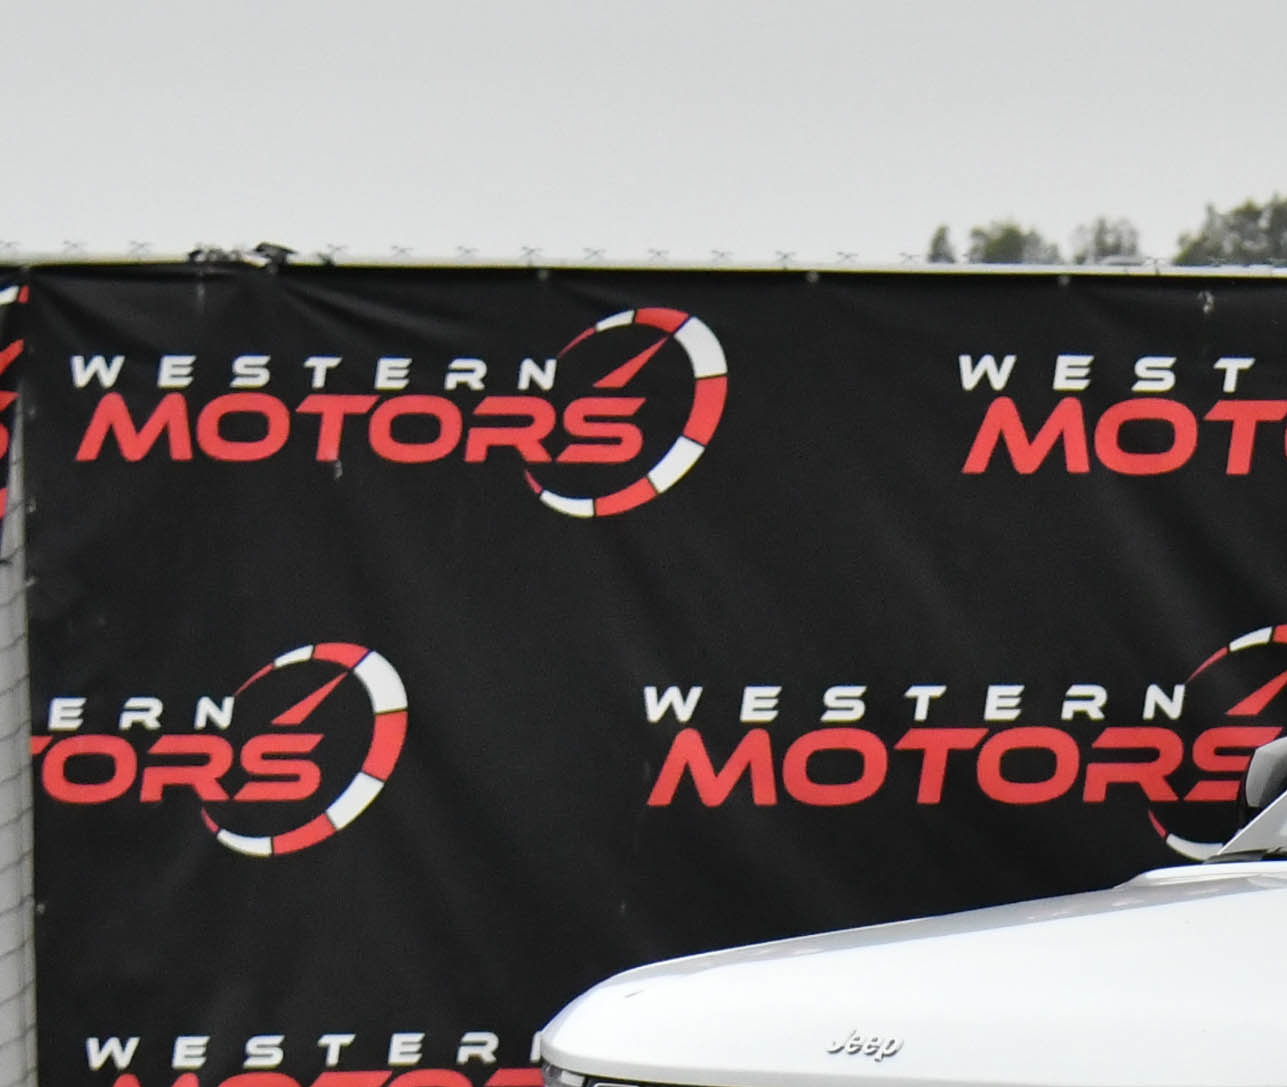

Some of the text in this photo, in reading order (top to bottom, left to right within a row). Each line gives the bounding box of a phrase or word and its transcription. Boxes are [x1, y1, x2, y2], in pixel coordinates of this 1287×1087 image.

[71, 355, 557, 391] WESTERN
[75, 392, 646, 463] MOTORS
[48, 696, 235, 731] ERN
[643, 684, 1186, 722] WESTERN
[647, 727, 1282, 806] MOTORS
[826, 1030, 904, 1063] Jeep
